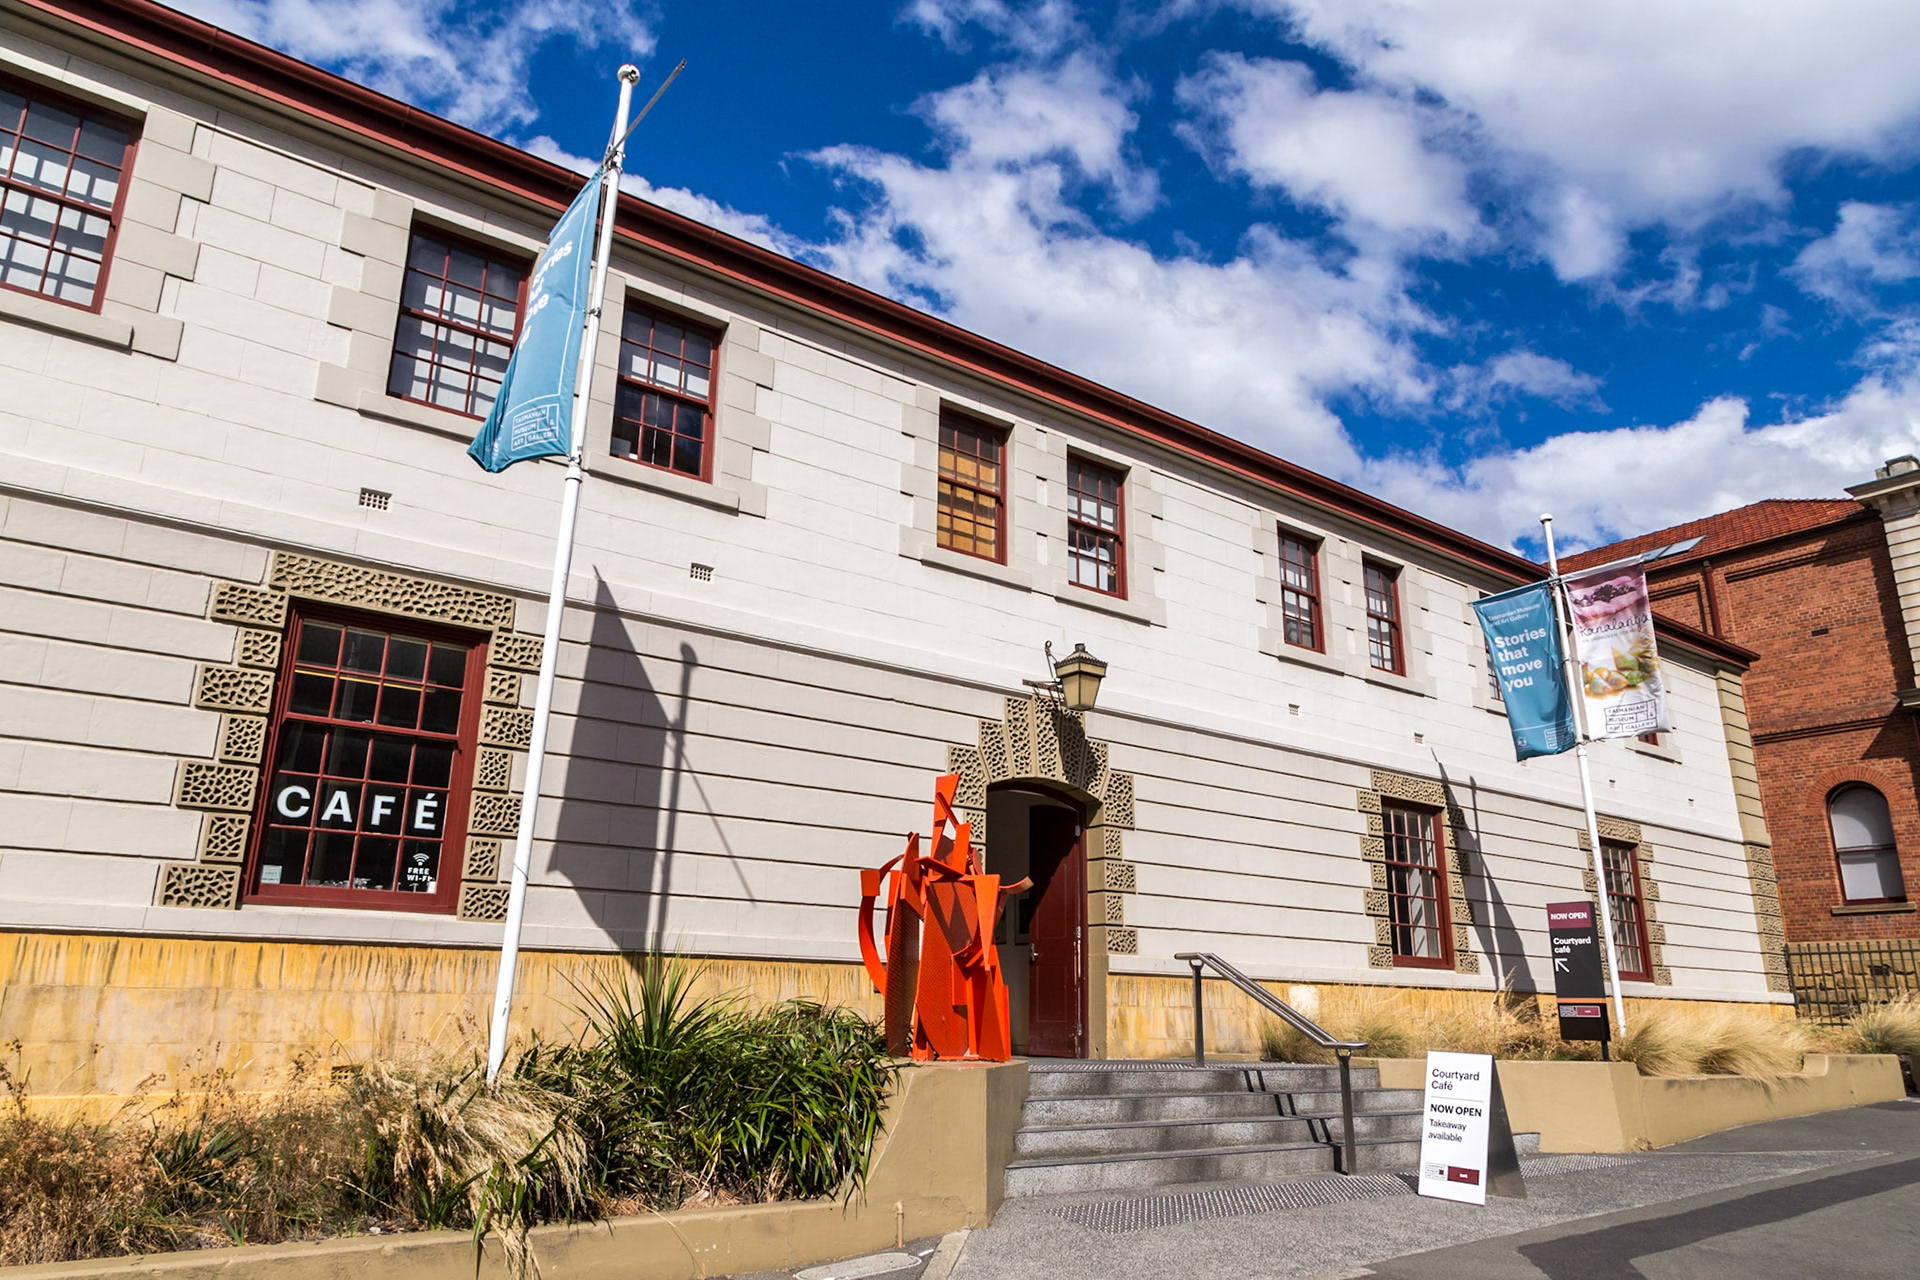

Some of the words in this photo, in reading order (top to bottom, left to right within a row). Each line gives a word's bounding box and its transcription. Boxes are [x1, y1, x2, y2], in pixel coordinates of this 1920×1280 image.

[515, 409, 546, 423] TASMANIAN
[514, 423, 536, 434] MUSEUM
[514, 438, 524, 446] ART
[1510, 613, 1529, 622] Gallery
[1494, 626, 1546, 648] Stories
[1498, 644, 1530, 662] that
[1502, 659, 1543, 677] move
[1504, 674, 1534, 692] you
[1608, 704, 1646, 714] TASMANIAN
[1626, 721, 1654, 730] GALLERY
[276, 786, 438, 830] CAFÉ
[408, 867, 430, 875] FREE
[1550, 912, 1568, 920] NOW
[1568, 912, 1588, 920] OPEN
[1553, 936, 1591, 946] Courtyard
[1554, 946, 1571, 954] café
[1432, 1068, 1480, 1081] Courtyard
[1431, 1080, 1454, 1091] Café
[1430, 1104, 1454, 1114] NOW
[1455, 1106, 1482, 1118] OPEN
[1430, 1118, 1467, 1132] Takeaway
[1428, 1132, 1462, 1143] available
